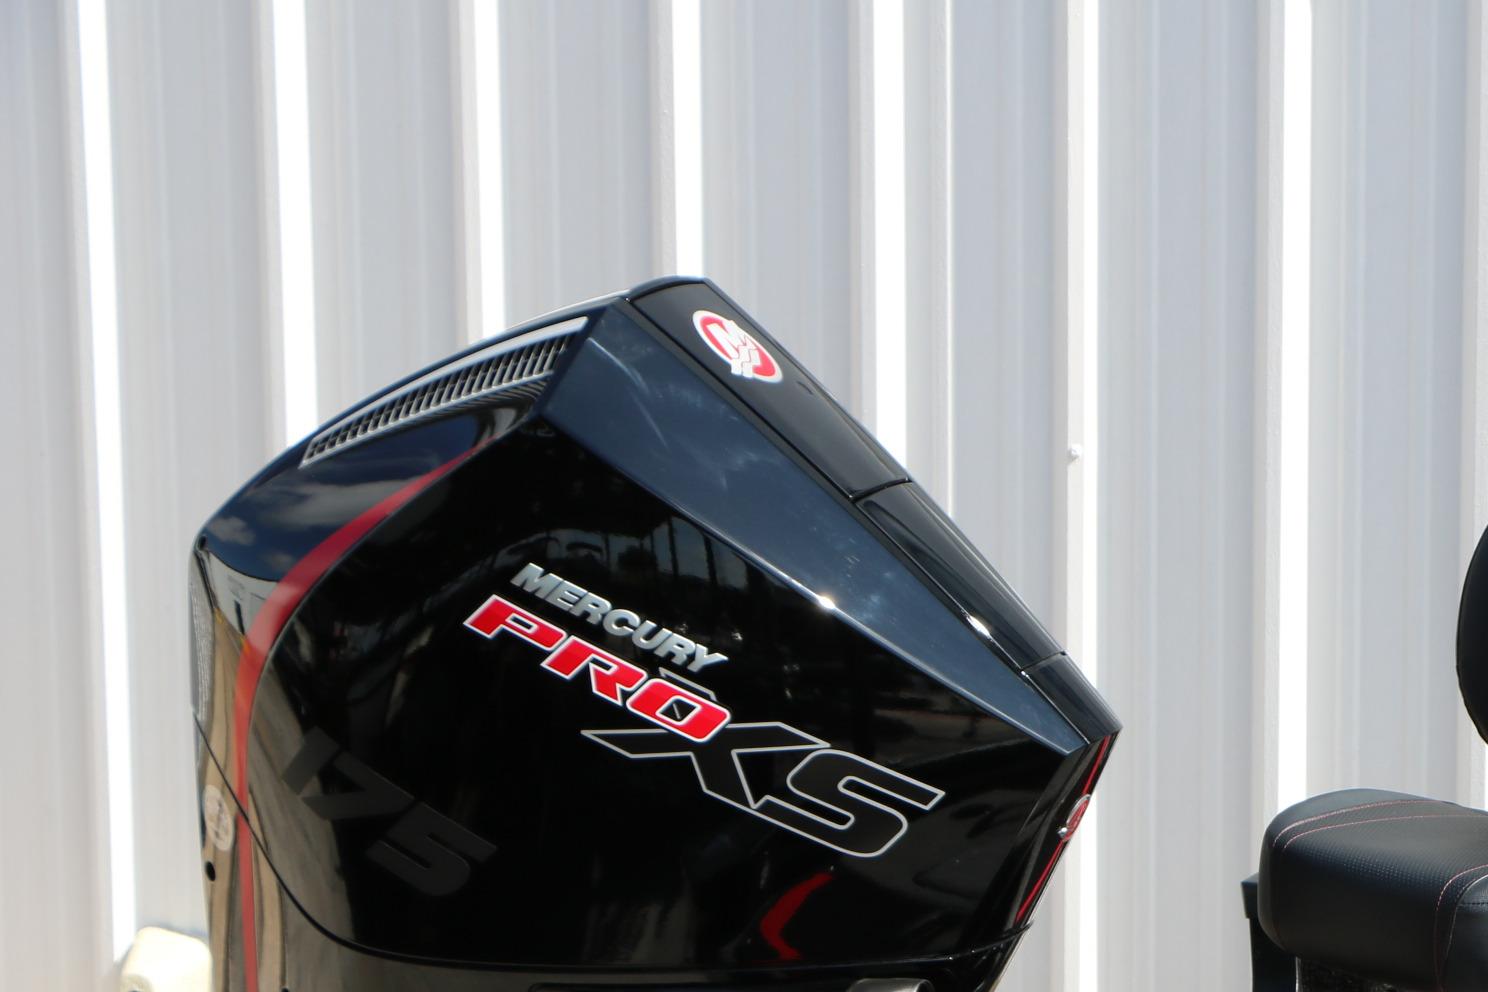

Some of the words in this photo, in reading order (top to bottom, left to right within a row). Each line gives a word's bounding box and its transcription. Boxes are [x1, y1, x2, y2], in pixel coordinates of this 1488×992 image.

[462, 593, 732, 743] PRO
[509, 562, 728, 673] MERCURY
[581, 668, 946, 858] XS
